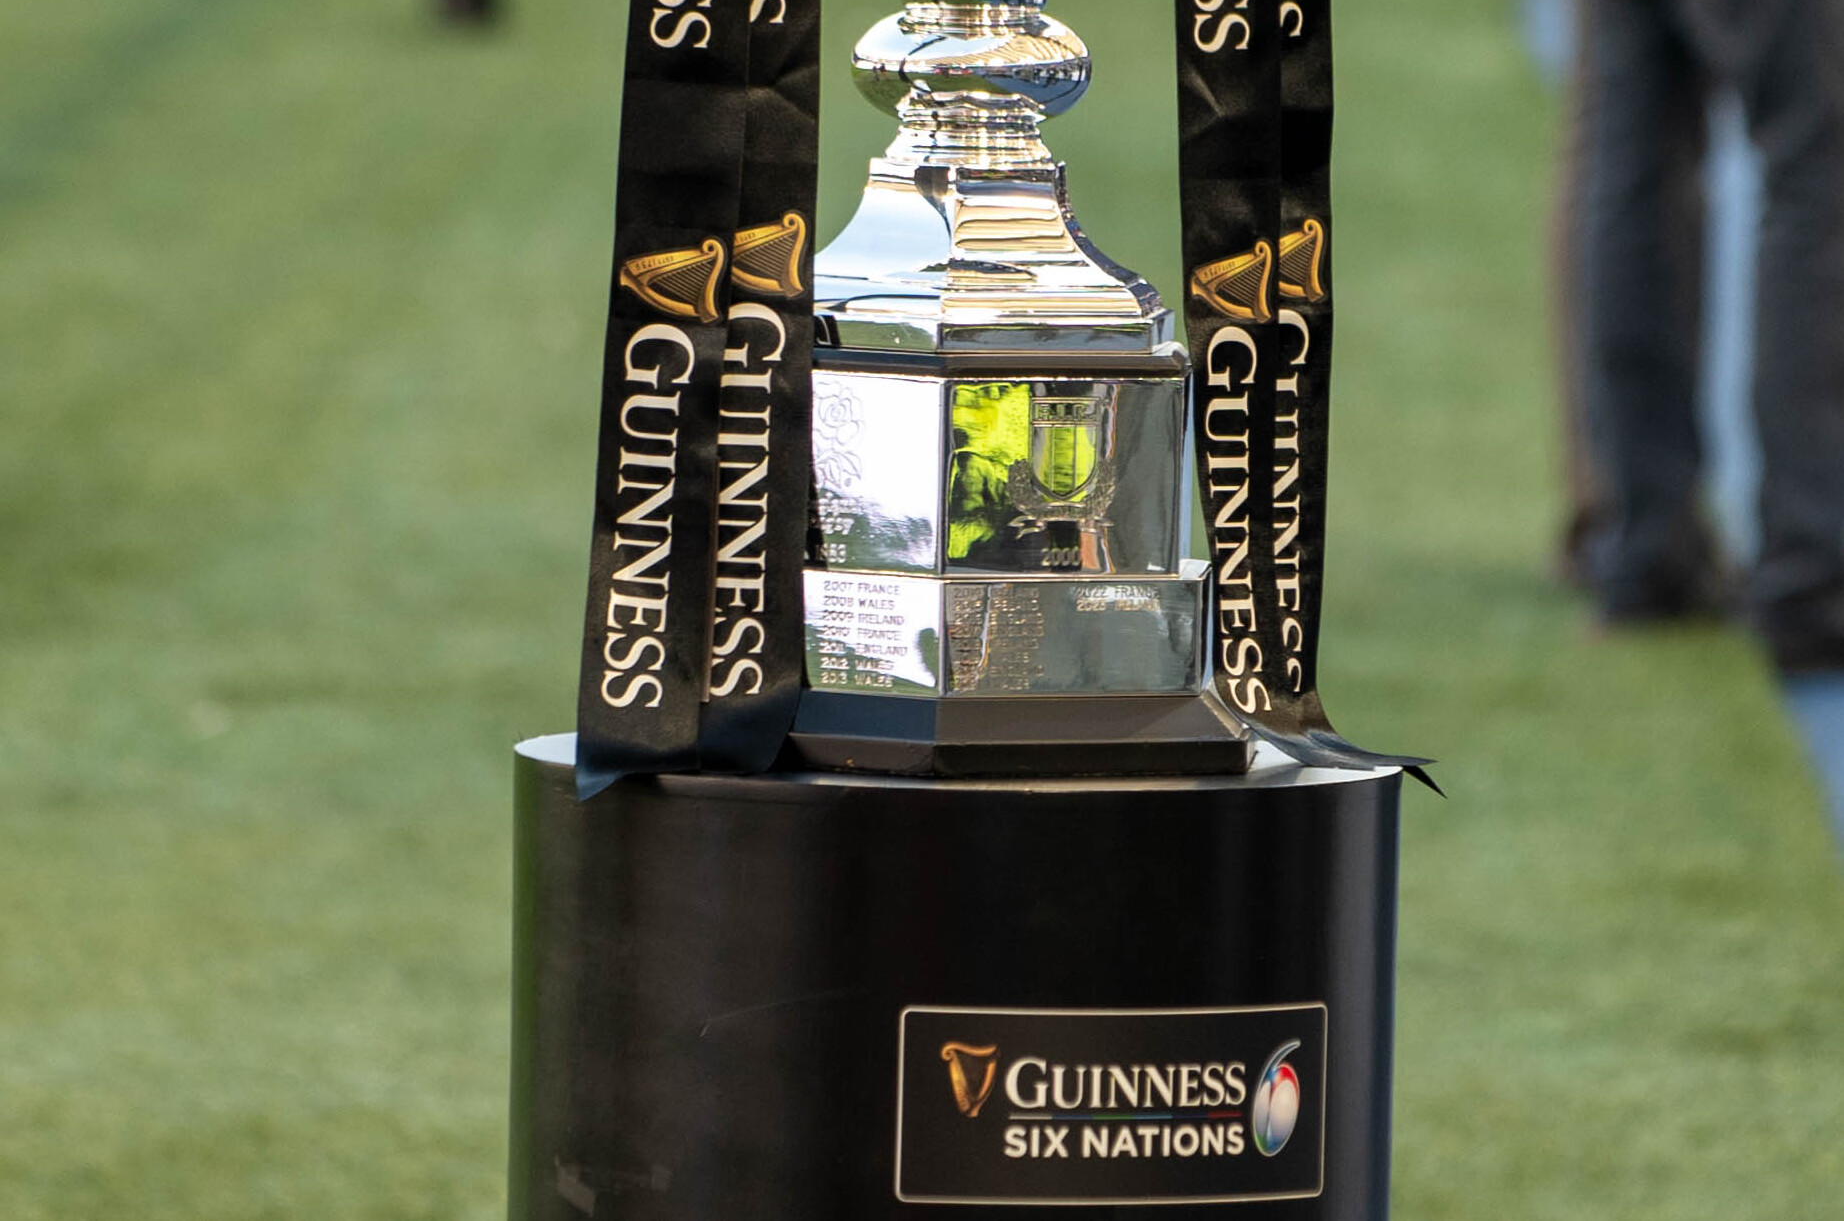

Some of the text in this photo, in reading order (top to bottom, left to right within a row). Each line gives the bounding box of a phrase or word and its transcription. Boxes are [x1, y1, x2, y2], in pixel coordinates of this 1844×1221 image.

[709, 302, 787, 697] GUINNESS
[601, 322, 696, 709] GUINNESS
[1205, 325, 1272, 714] GUINNESS
[1041, 547, 1080, 566] 2000
[823, 580, 901, 595] 2007 FRANCE
[858, 598, 895, 610] WALES
[858, 613, 905, 626] IRELAND
[857, 627, 901, 640] FRANCE
[855, 673, 893, 688] WALES
[1004, 1056, 1247, 1110] GUINNESS
[1003, 1124, 1245, 1158] SIX NATIONS
